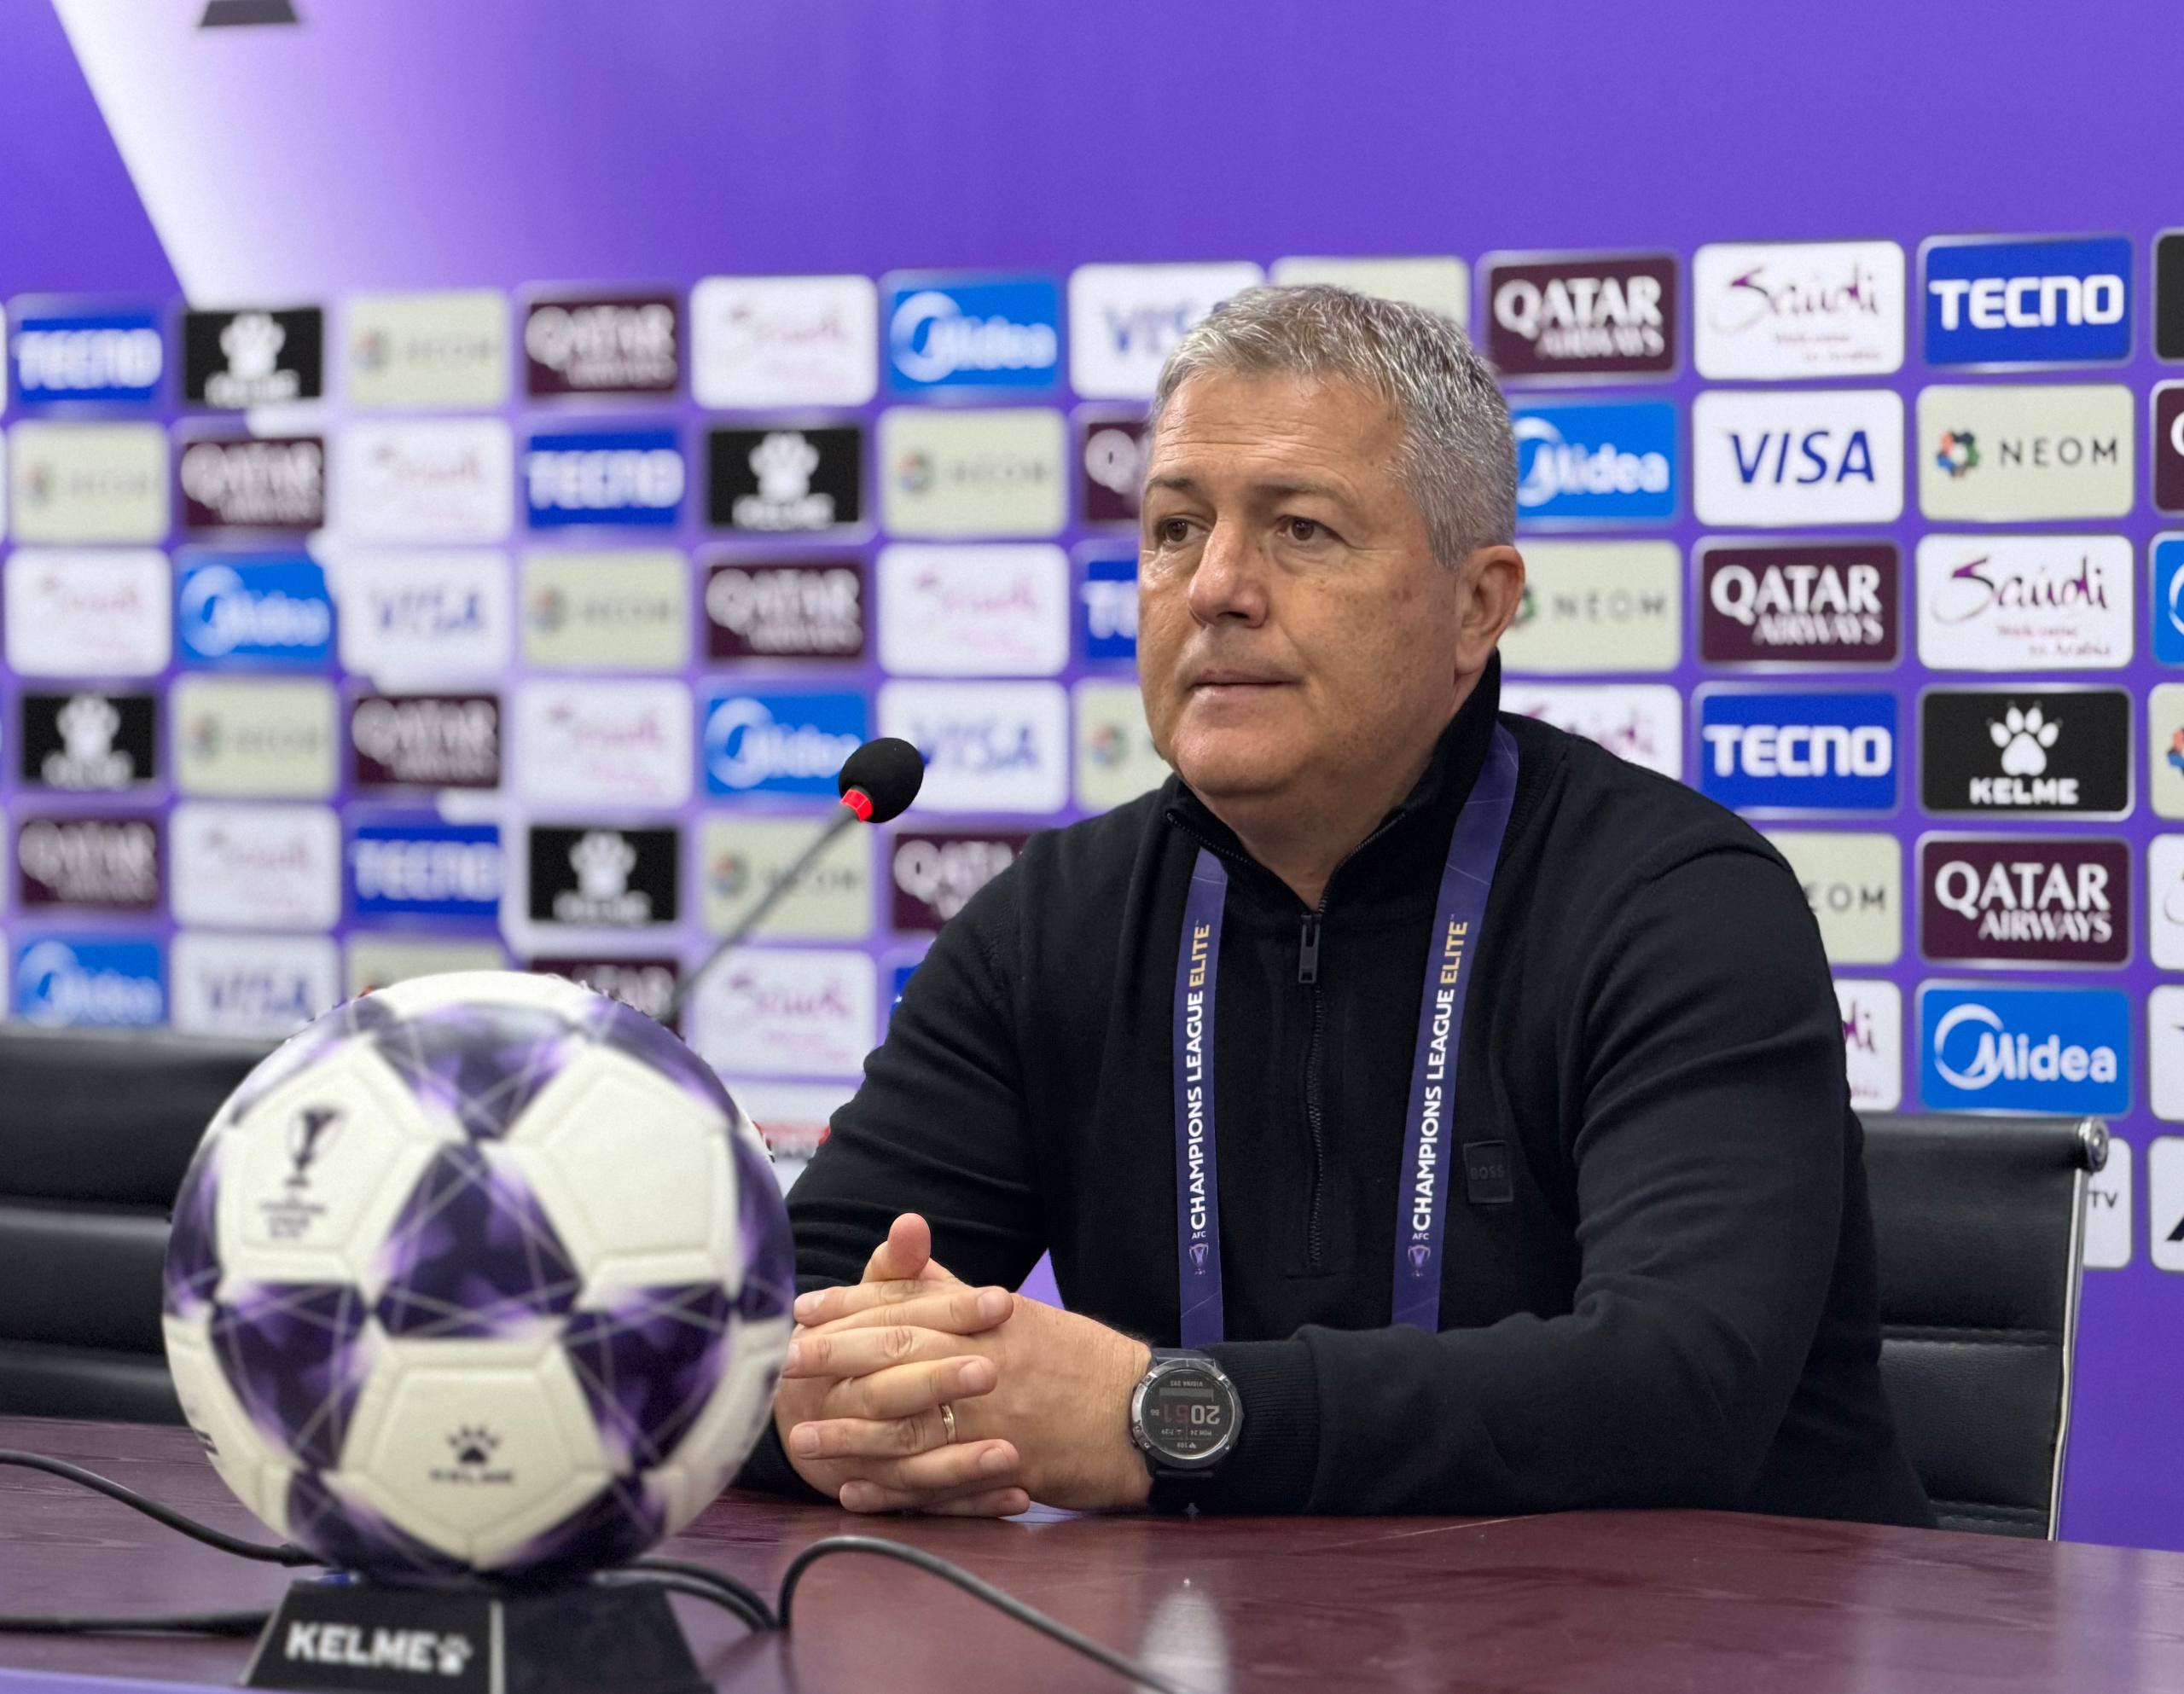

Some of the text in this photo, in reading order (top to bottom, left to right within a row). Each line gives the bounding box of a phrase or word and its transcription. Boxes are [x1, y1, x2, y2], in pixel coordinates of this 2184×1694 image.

[1495, 276, 1663, 339] QATAR
[1929, 274, 2124, 330] TECNO
[1513, 417, 1669, 507] Midea
[1729, 430, 1875, 484] VISA
[1999, 438, 2117, 466] NEOM
[1710, 565, 1882, 625] QATAR
[1702, 725, 1891, 776] TECNO
[1969, 776, 2079, 805] KELME
[1804, 882, 1886, 914] EOM
[1935, 861, 2111, 920] QATAR
[1979, 910, 2111, 943] AIRWAYS
[1935, 1003, 2117, 1090] Midea
[1187, 925, 1210, 1230] CHAMPIONS LEAGUE ELITE
[1413, 921, 1467, 1231] CHAMPIONS LEAGUE ELITE
[1469, 1165, 1505, 1181] BOSS
[2088, 1190, 2118, 1210] TV
[1191, 1231, 1206, 1239] AFC
[1190, 1405, 1220, 1424] 20
[285, 1621, 438, 1672] KELME
